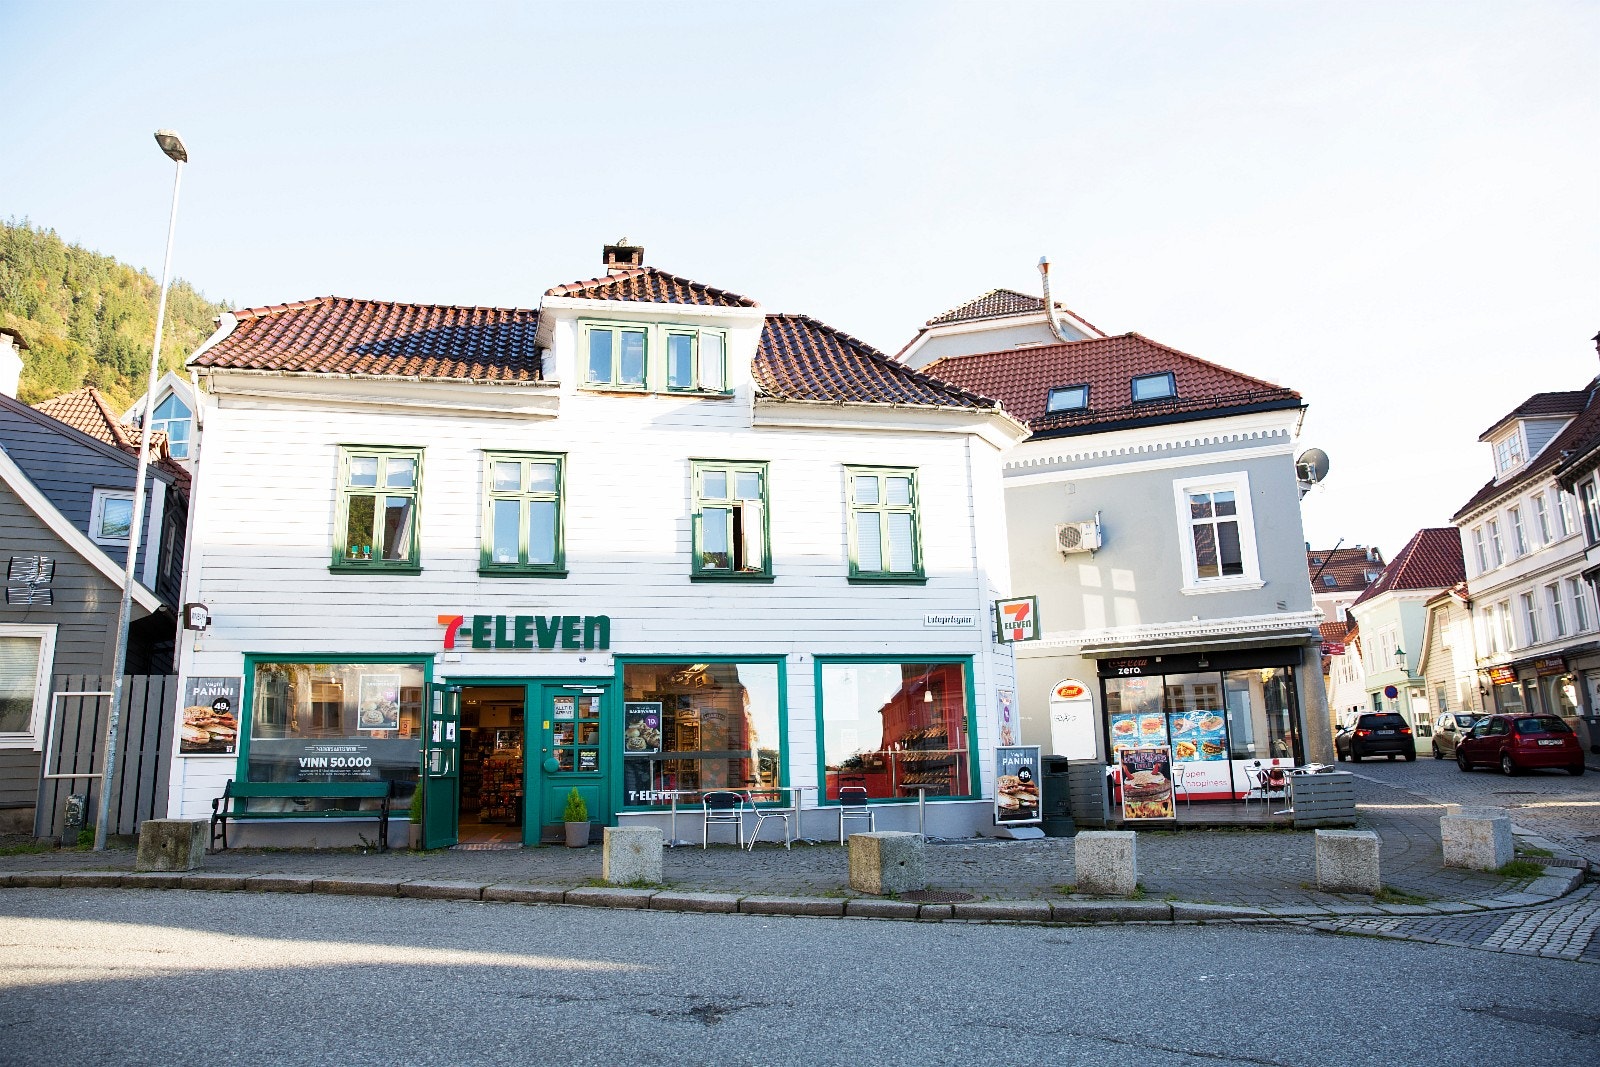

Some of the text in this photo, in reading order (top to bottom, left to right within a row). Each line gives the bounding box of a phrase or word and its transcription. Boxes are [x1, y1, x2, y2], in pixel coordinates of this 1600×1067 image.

[1117, 667, 1140, 675] zero
[193, 687, 234, 696] PANINI
[299, 757, 372, 768] VINN 50.000
[1002, 757, 1033, 766] PANINI
[1185, 770, 1206, 778] open
[1185, 780, 1228, 788] happiness
